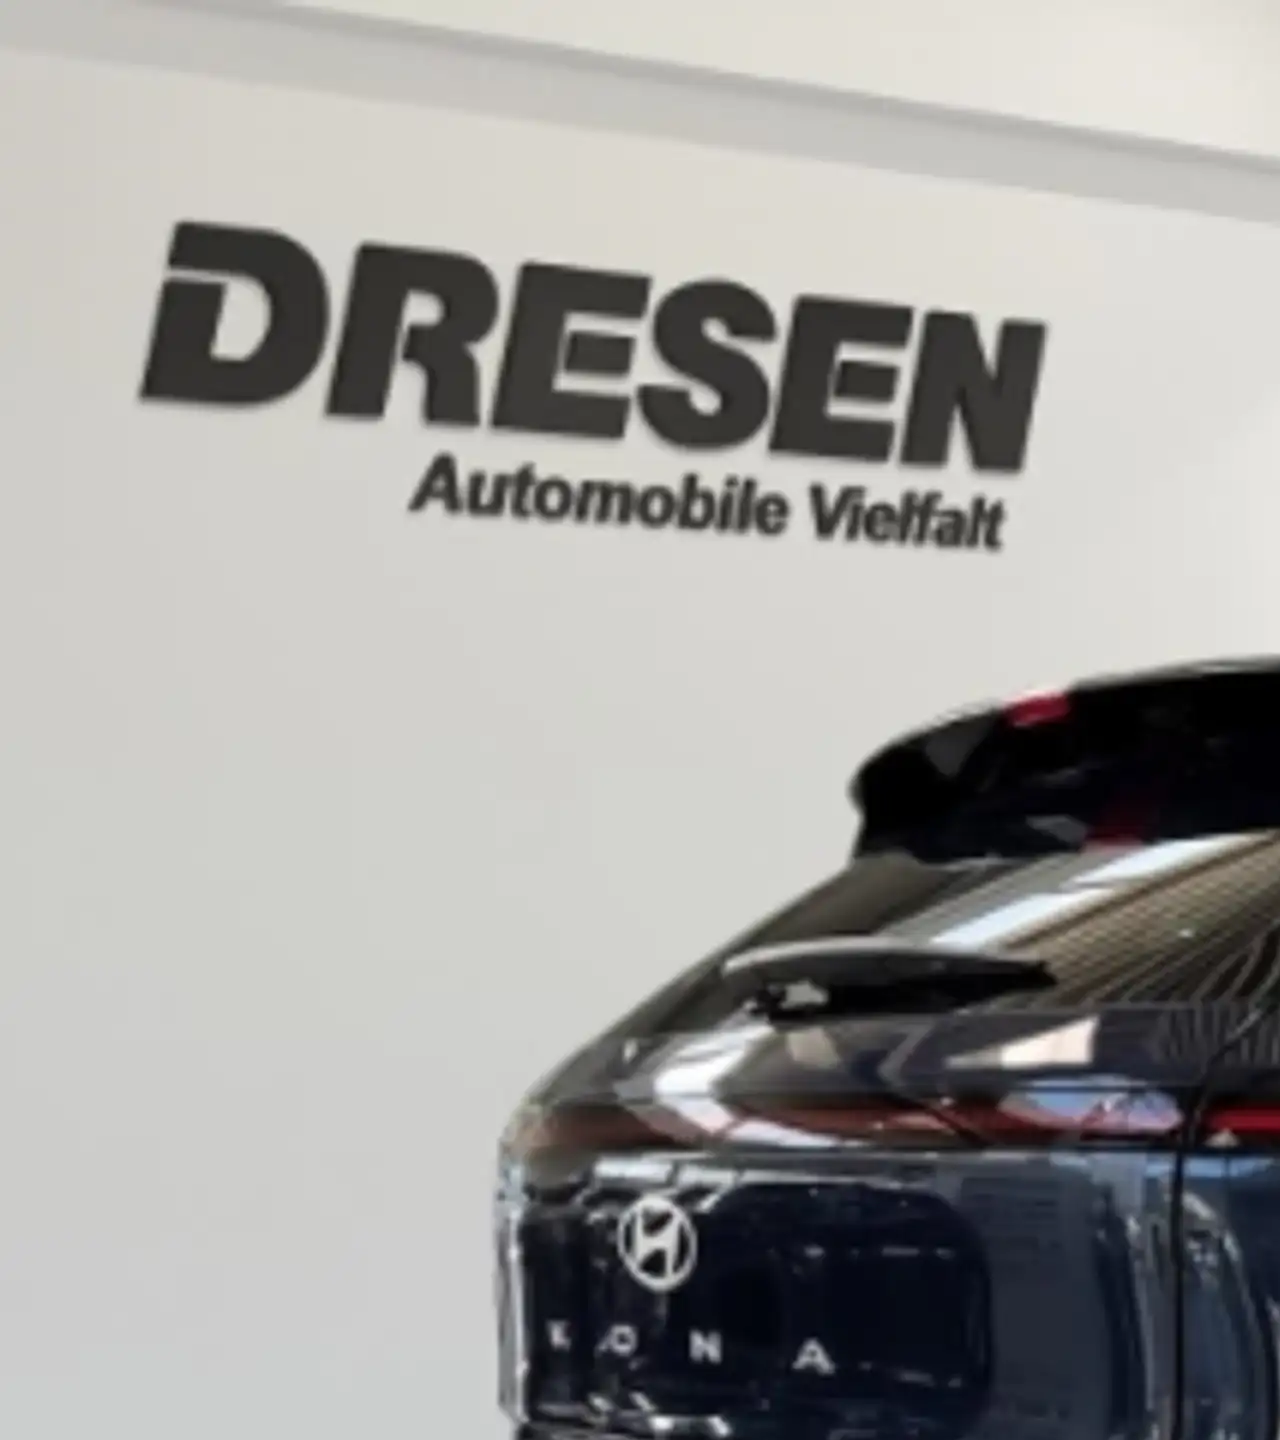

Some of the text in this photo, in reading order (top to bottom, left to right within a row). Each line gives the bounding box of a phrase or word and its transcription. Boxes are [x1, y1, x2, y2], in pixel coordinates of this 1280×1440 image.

[139, 220, 1047, 475] DRESEN
[408, 452, 1006, 551] Automobile Vielfalt
